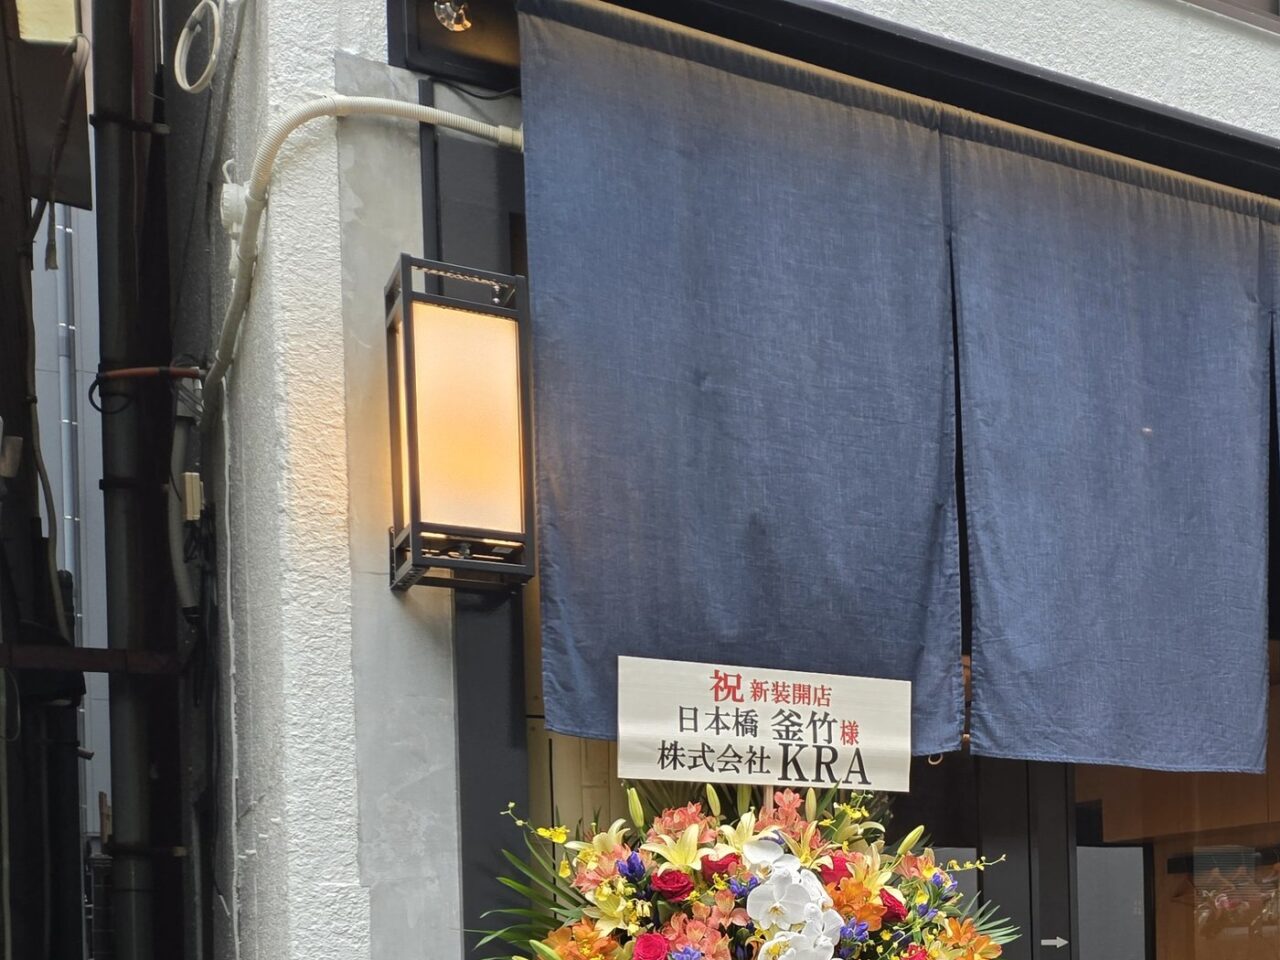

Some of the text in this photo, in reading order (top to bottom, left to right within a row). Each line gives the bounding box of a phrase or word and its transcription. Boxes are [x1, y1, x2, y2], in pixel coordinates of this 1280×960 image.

[710, 669, 833, 707] 祝 新装開店
[678, 705, 759, 738] 日本橋
